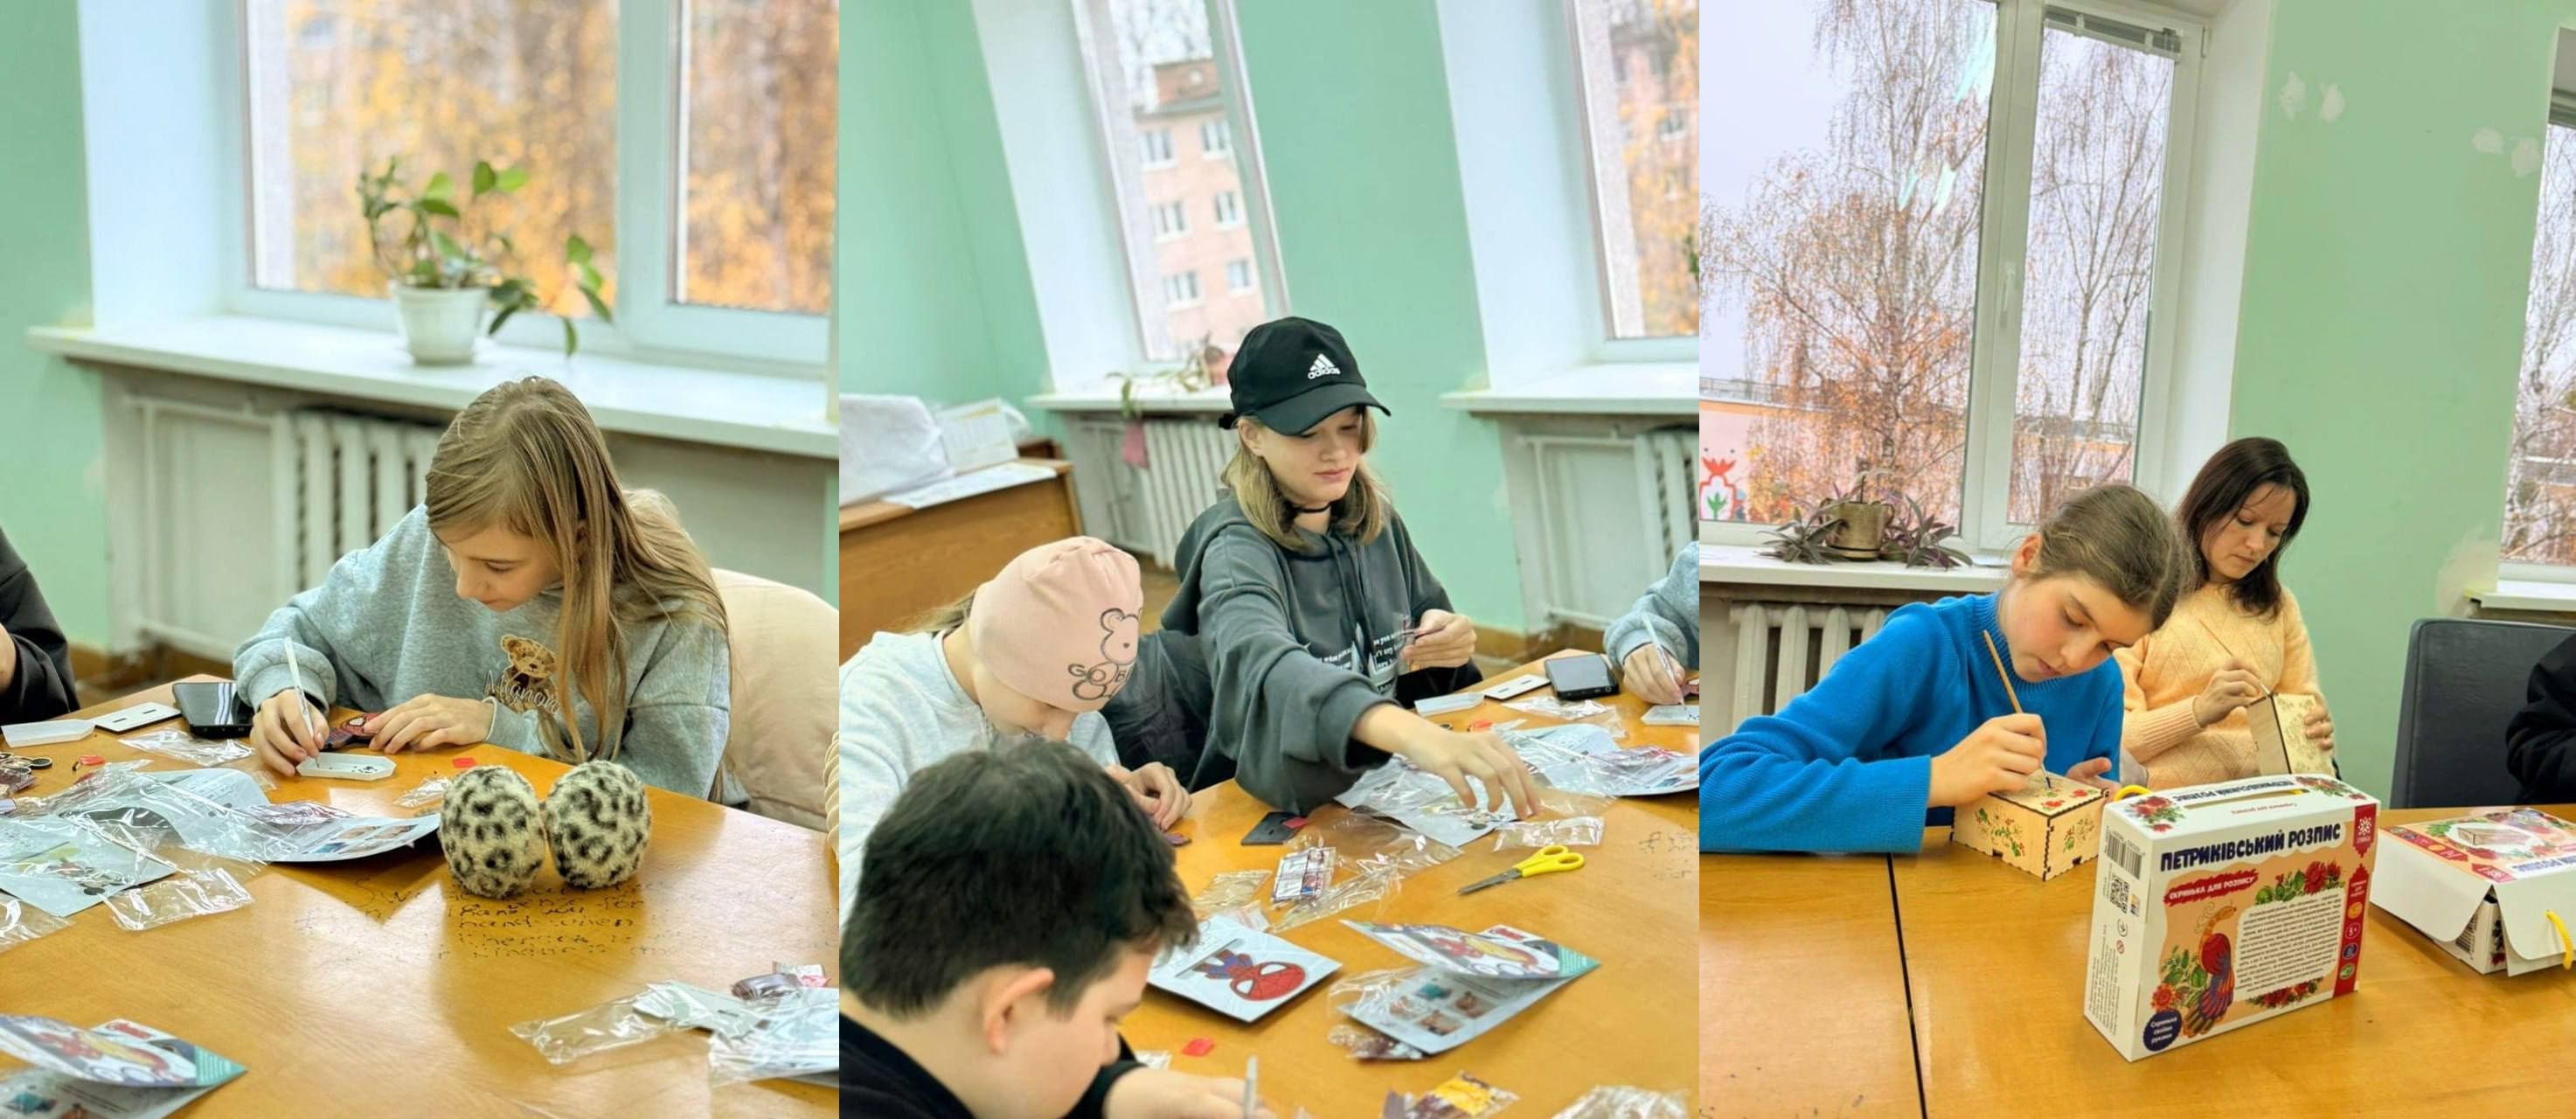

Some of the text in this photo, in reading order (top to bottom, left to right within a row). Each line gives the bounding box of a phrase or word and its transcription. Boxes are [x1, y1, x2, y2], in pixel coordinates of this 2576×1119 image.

[1308, 367, 1341, 379] adidas
[2160, 830, 2285, 872] ПЕТРИКІВСЬКИЙ
[2288, 823, 2342, 849] РОЗПИС
